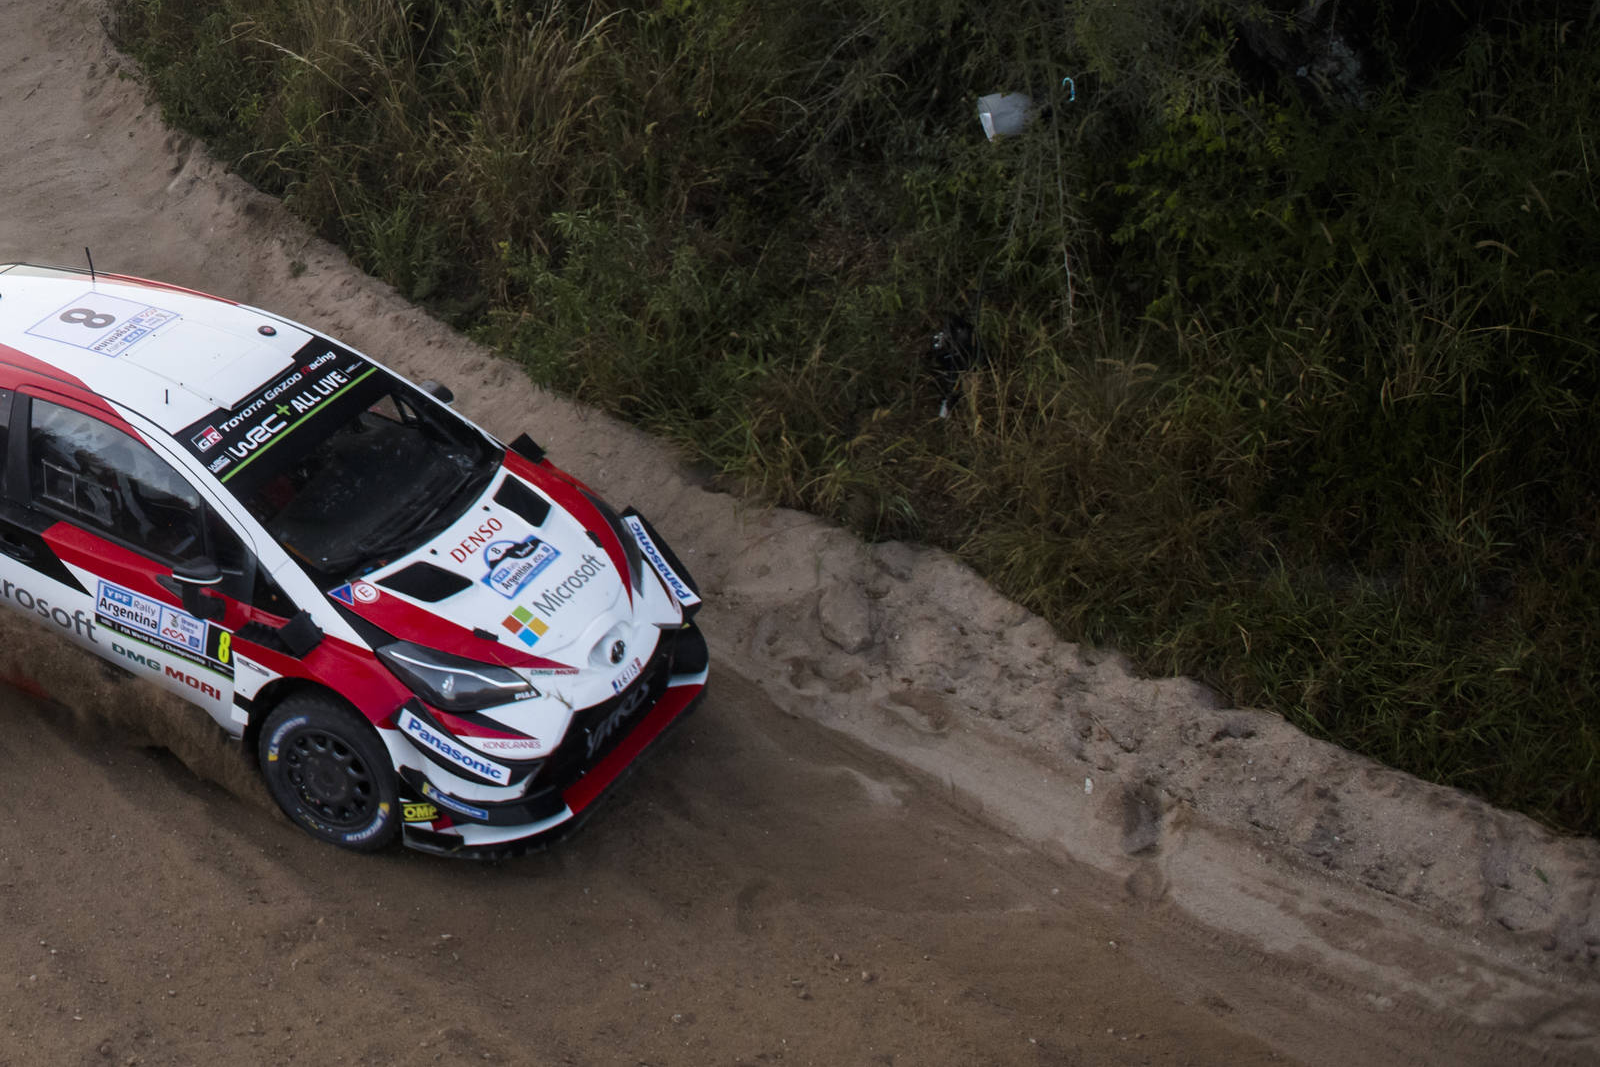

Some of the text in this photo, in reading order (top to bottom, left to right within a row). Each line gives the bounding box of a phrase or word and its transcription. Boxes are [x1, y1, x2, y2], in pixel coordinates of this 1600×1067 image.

[60, 308, 116, 329] 8
[198, 430, 221, 450] GR
[219, 399, 266, 433] TOYOTA
[264, 372, 303, 401] GAZOO
[301, 351, 337, 375] Racing
[290, 391, 322, 414] ALL
[312, 370, 348, 396] LIVE
[449, 517, 503, 563] DENSO
[491, 547, 501, 555] 8
[501, 562, 534, 590] Argentina
[631, 522, 691, 600] Panasonic
[105, 588, 157, 616] YPF Rally
[532, 554, 606, 617] Microsoft
[100, 597, 158, 630] Argentina
[218, 631, 232, 664] 8
[111, 642, 161, 672] DMG
[165, 665, 221, 701] MORI
[408, 717, 502, 779] Panasonic
[403, 806, 437, 819] OMP
